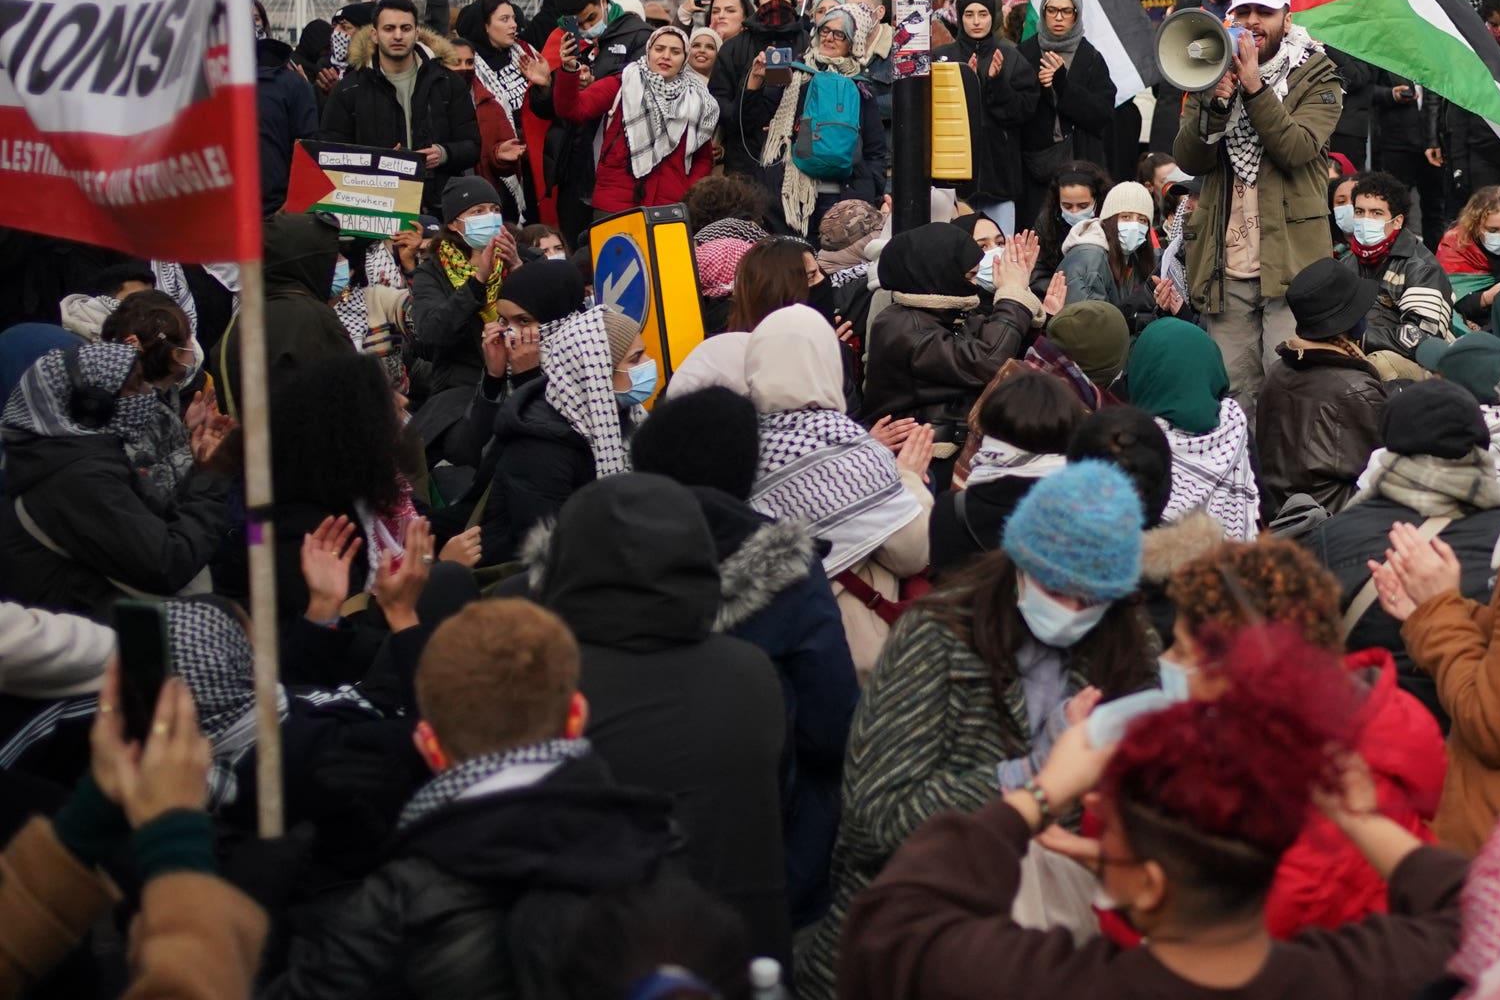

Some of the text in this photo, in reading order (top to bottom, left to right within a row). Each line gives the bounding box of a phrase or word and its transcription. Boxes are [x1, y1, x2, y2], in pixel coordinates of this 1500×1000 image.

[319, 153, 415, 174] Death to settler
[343, 174, 397, 188] Colonialism
[335, 191, 393, 208] Everywhere!
